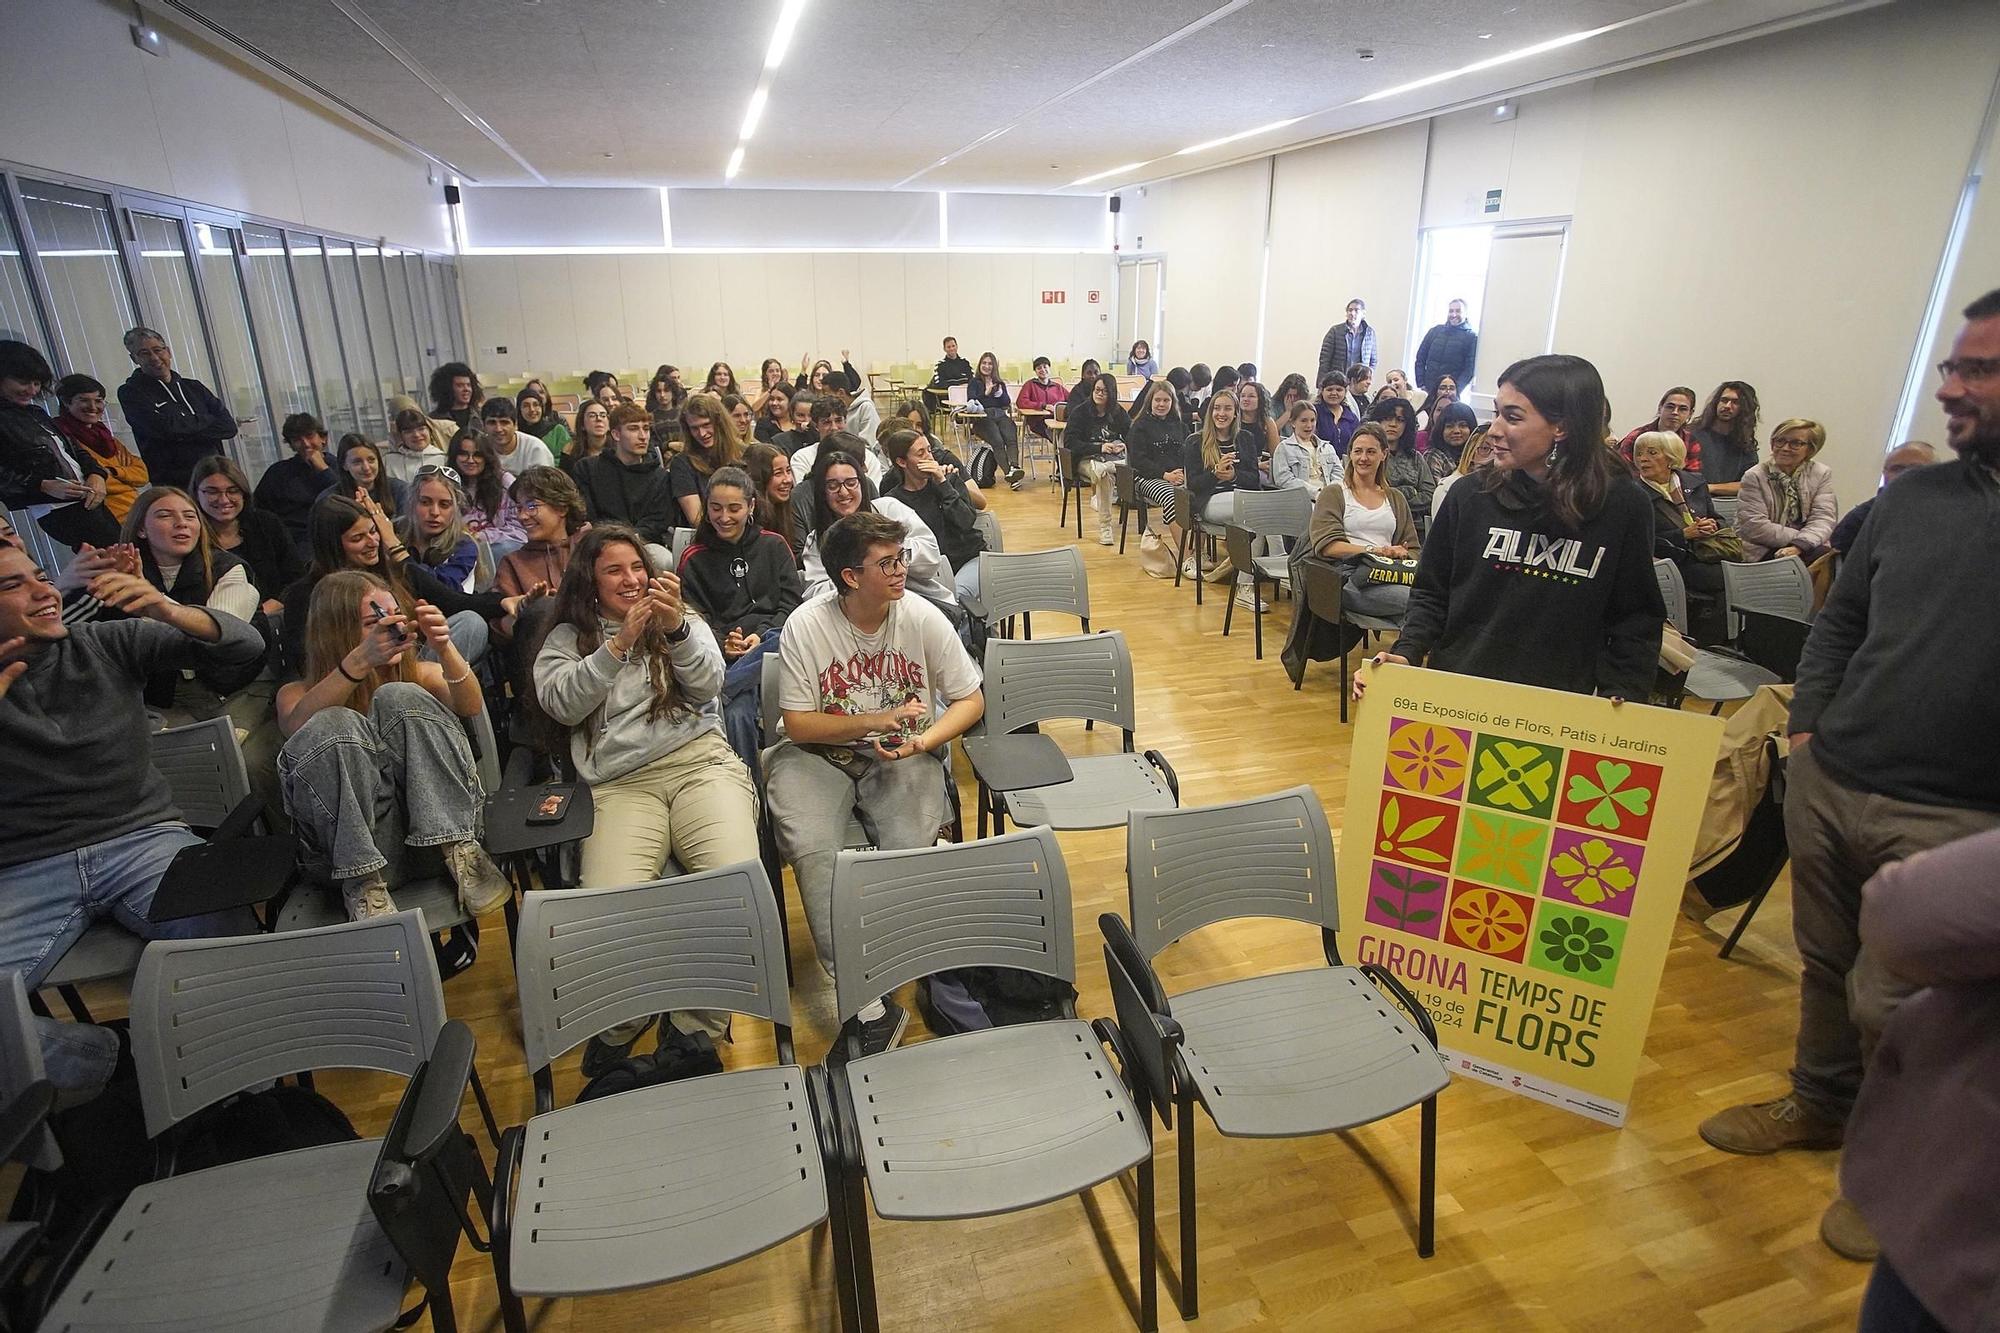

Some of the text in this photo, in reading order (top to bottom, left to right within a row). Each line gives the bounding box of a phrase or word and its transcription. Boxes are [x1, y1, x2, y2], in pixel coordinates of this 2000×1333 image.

[1369, 567, 1416, 585] TERRA NO
[1482, 526, 1606, 579] AUXILI
[1393, 697, 1668, 755] 69a Exposició de Flors, Patis i Jardins
[1358, 935, 1468, 995] GIRONA
[1425, 993, 1442, 1007] 19
[1445, 1000, 1465, 1014] de
[1480, 967, 1606, 1028] TEMPS DE
[1473, 999, 1598, 1067] FLORS
